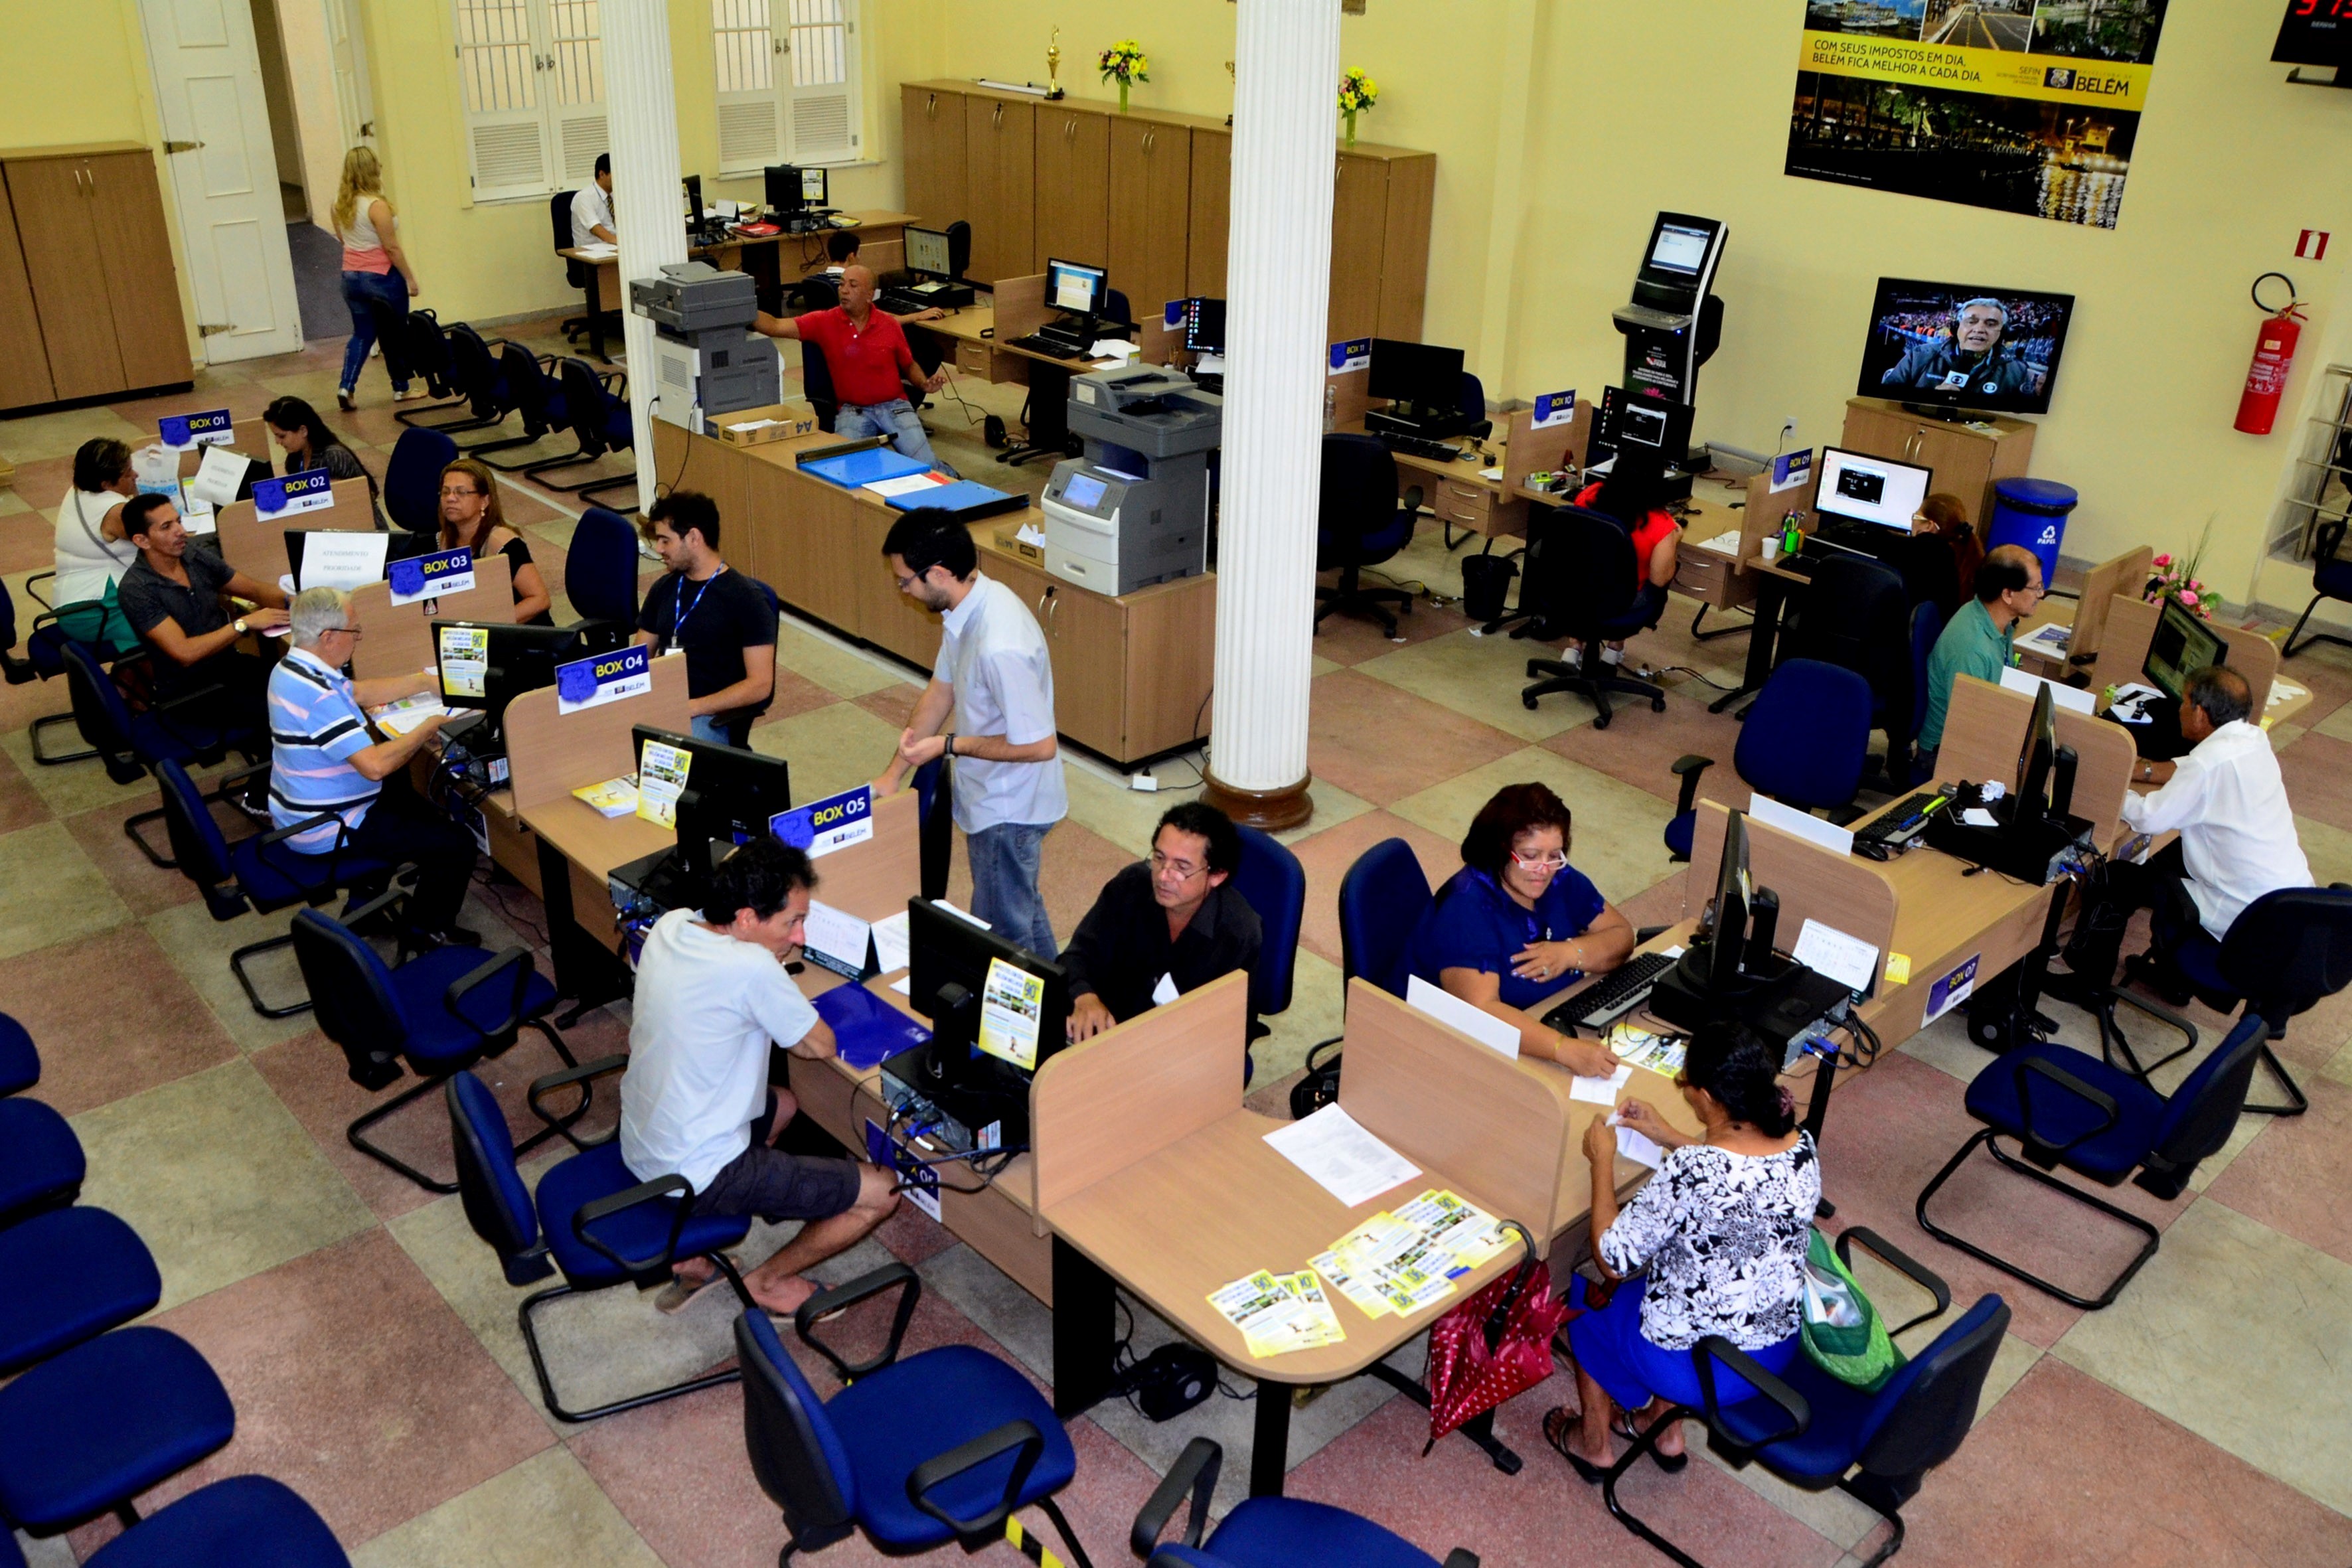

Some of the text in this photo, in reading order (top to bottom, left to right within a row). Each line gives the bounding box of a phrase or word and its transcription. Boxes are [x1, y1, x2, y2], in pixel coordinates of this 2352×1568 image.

[1814, 39, 1838, 52] COM
[1840, 42, 1867, 55] SEUS
[1868, 45, 1925, 62] IMPOSTOS
[1926, 52, 1943, 63] EM
[1812, 52, 1983, 83] BELÉM FICA MELHOR A CADA DIA.
[2019, 66, 2041, 76] SEFIN
[2075, 76, 2130, 97] BELÉM
[1346, 345, 1360, 354] BOX
[1551, 395, 1572, 407] BOX 10
[190, 416, 225, 430] BOX 01
[1789, 454, 1810, 468] BOX 09
[285, 475, 326, 493] BOX 02
[424, 555, 468, 575] BOX 03
[595, 654, 644, 678] BOX 04
[813, 796, 866, 826] BOX 05
[1948, 962, 1976, 989] BOX 07
